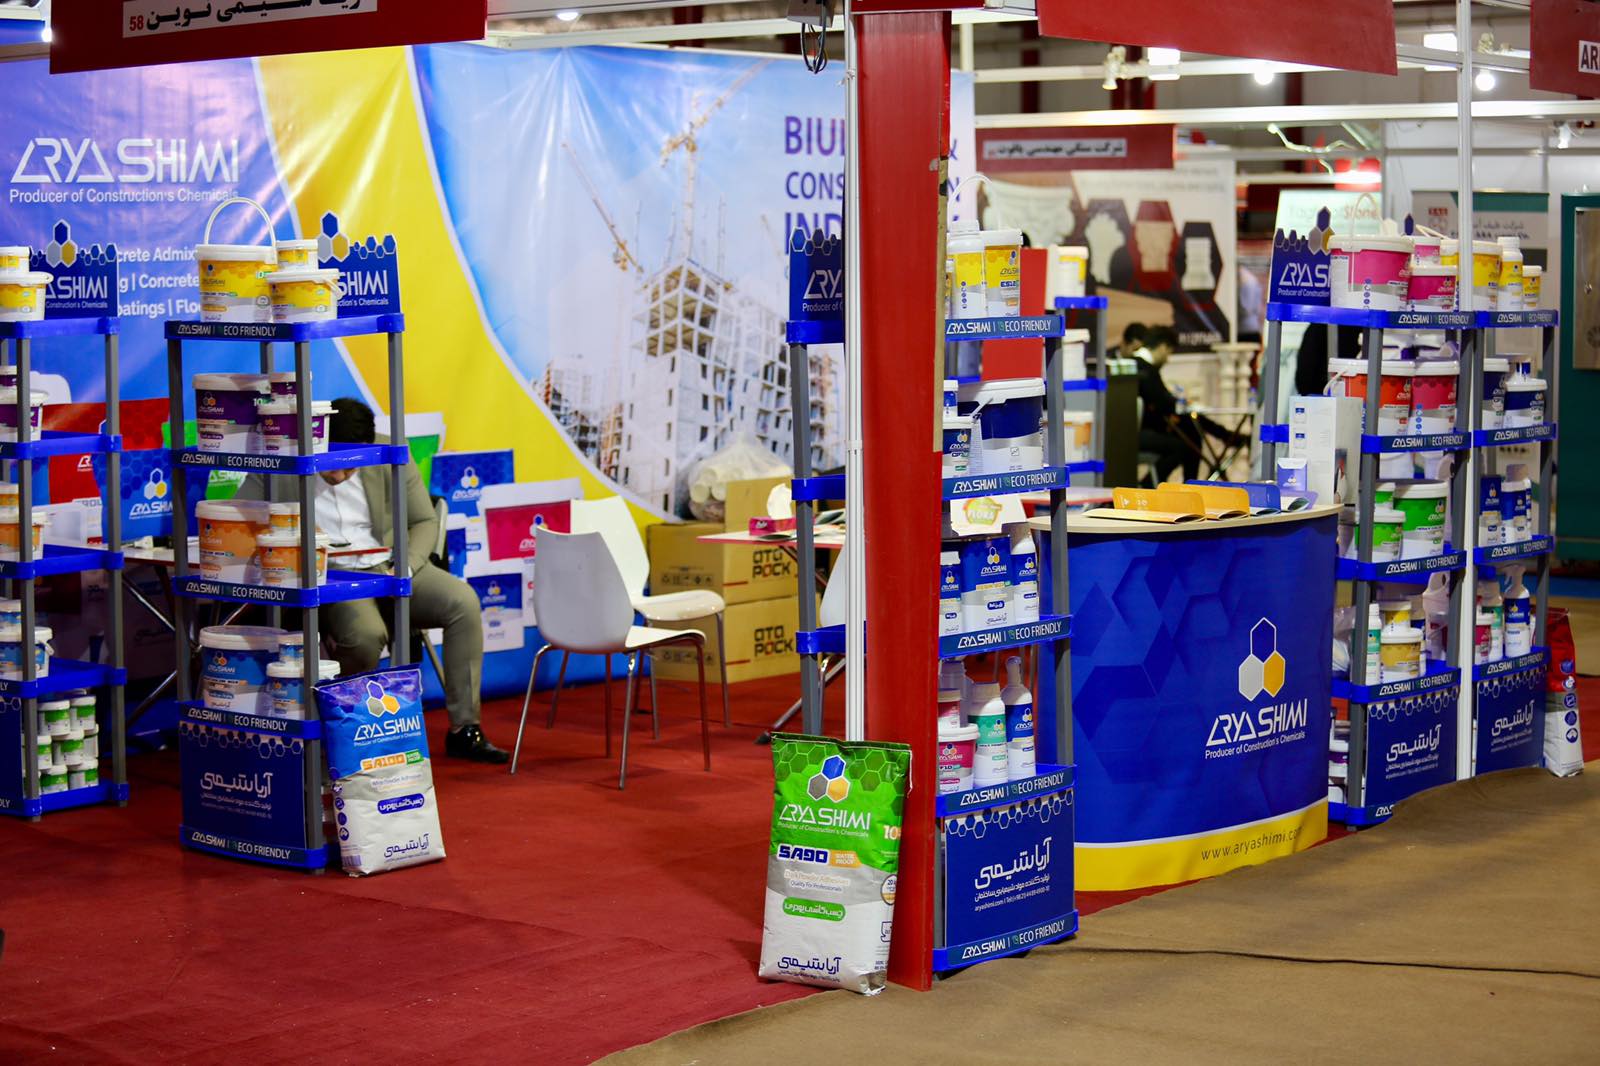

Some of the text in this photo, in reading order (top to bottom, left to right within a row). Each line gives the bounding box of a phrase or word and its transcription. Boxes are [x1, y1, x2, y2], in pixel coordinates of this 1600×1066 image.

[129, 15, 144, 31] 58
[10, 188, 67, 203] Producer
[71, 188, 84, 202] of
[178, 188, 238, 203] Chemicals
[118, 247, 198, 263] crete Admix
[139, 273, 200, 288] Concrete
[338, 270, 388, 295] SHIMI
[1279, 263, 1330, 287] ARYAS
[46, 275, 108, 299] ASHIMI
[803, 269, 842, 299] ARY
[1303, 288, 1329, 298] Construction
[802, 302, 831, 312] Producer
[224, 326, 238, 336] ECO
[240, 326, 276, 337] FRIENDLY
[1005, 321, 1020, 332] ECO
[1021, 320, 1051, 331] FRIENDLY
[227, 457, 242, 467] ECO
[244, 457, 281, 469] FRIENDLY
[1011, 476, 1026, 488] ECO
[1027, 472, 1056, 486] FRIENDLY
[232, 587, 247, 598] ECO
[249, 588, 285, 600] FRIENDLY
[1015, 627, 1031, 640] ECO
[1031, 621, 1062, 636] FRIENDLY
[234, 716, 250, 728] ECO
[251, 717, 287, 731] FRIENDLY
[1205, 746, 1235, 760] Producer
[1236, 744, 1242, 754] of
[1280, 730, 1305, 744] Chemicals
[1018, 782, 1033, 794] ECO
[1034, 773, 1064, 790] FRIENDLY
[238, 842, 253, 853] ECO
[254, 844, 290, 859] FRIENDLY
[1019, 931, 1034, 945] ECO
[1035, 920, 1064, 939] FRIENDLY
